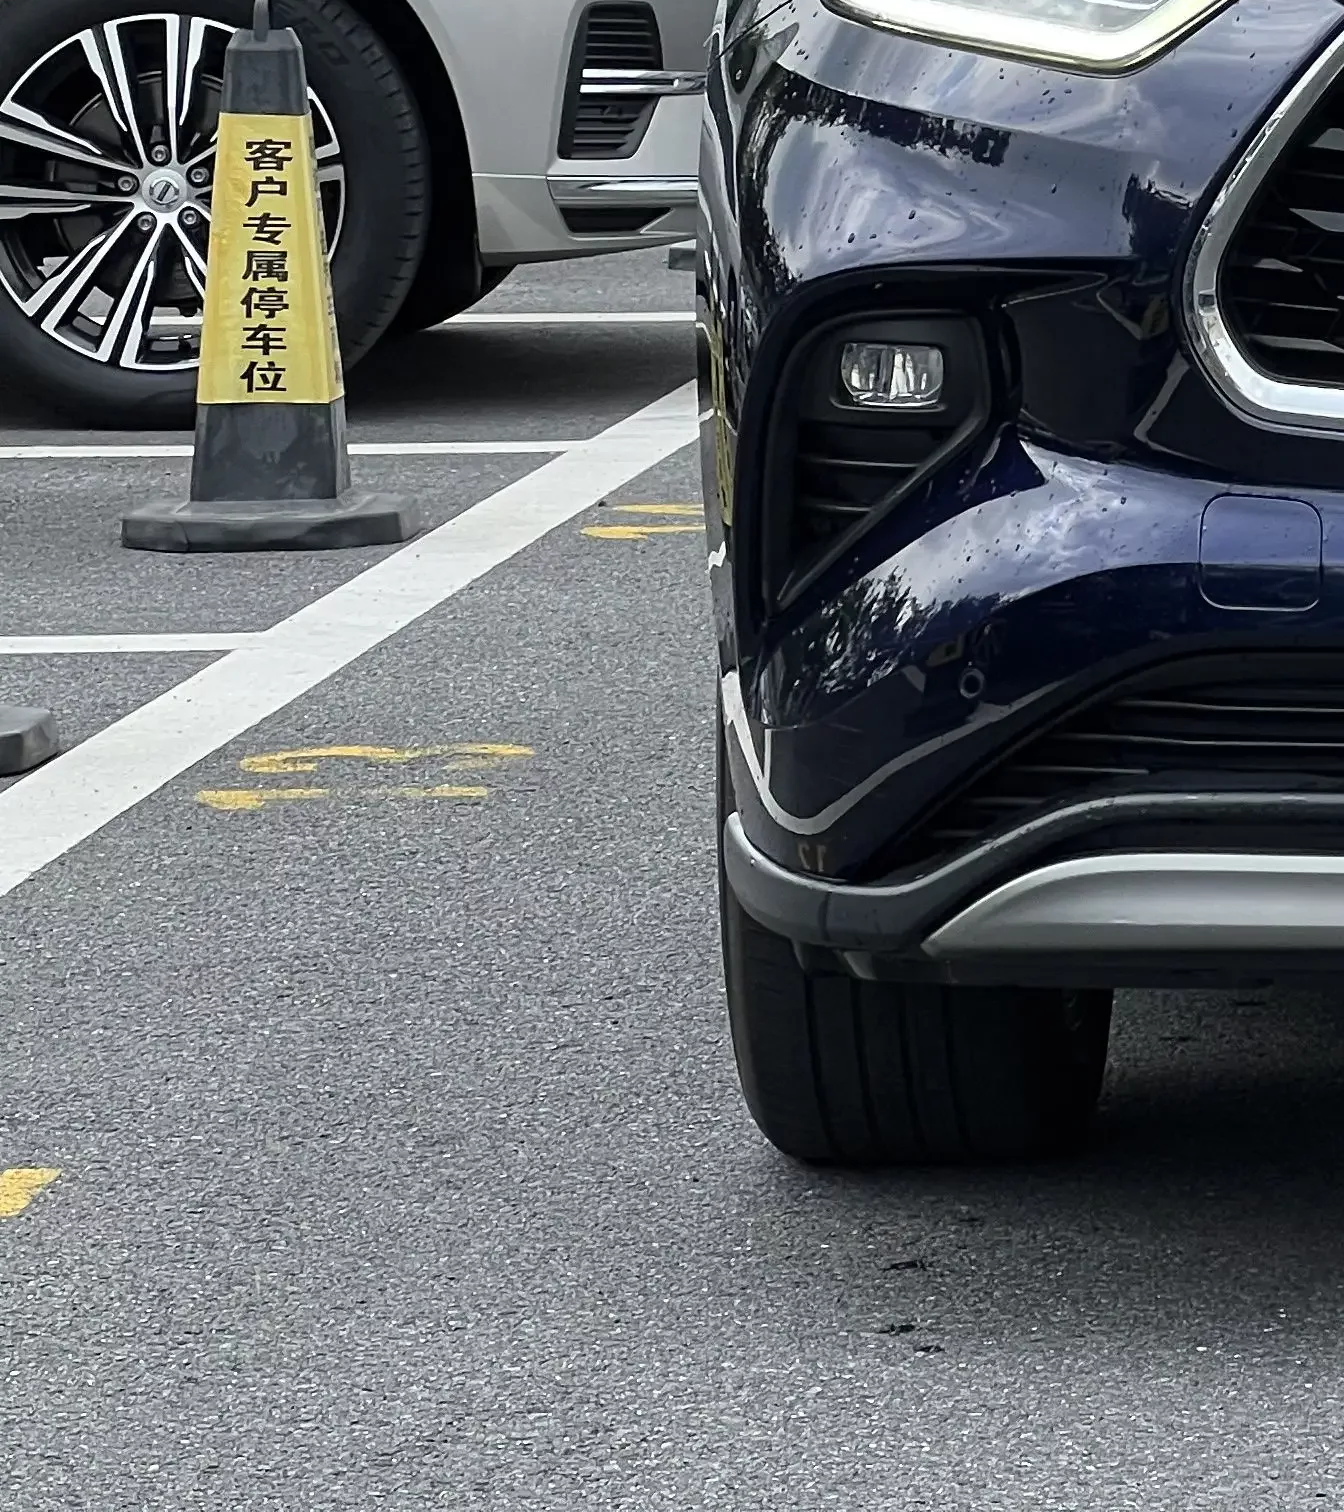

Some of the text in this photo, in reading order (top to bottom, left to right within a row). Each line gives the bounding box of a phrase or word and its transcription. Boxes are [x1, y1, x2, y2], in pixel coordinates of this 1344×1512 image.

[240, 138, 293, 394] 客户专属停车位
